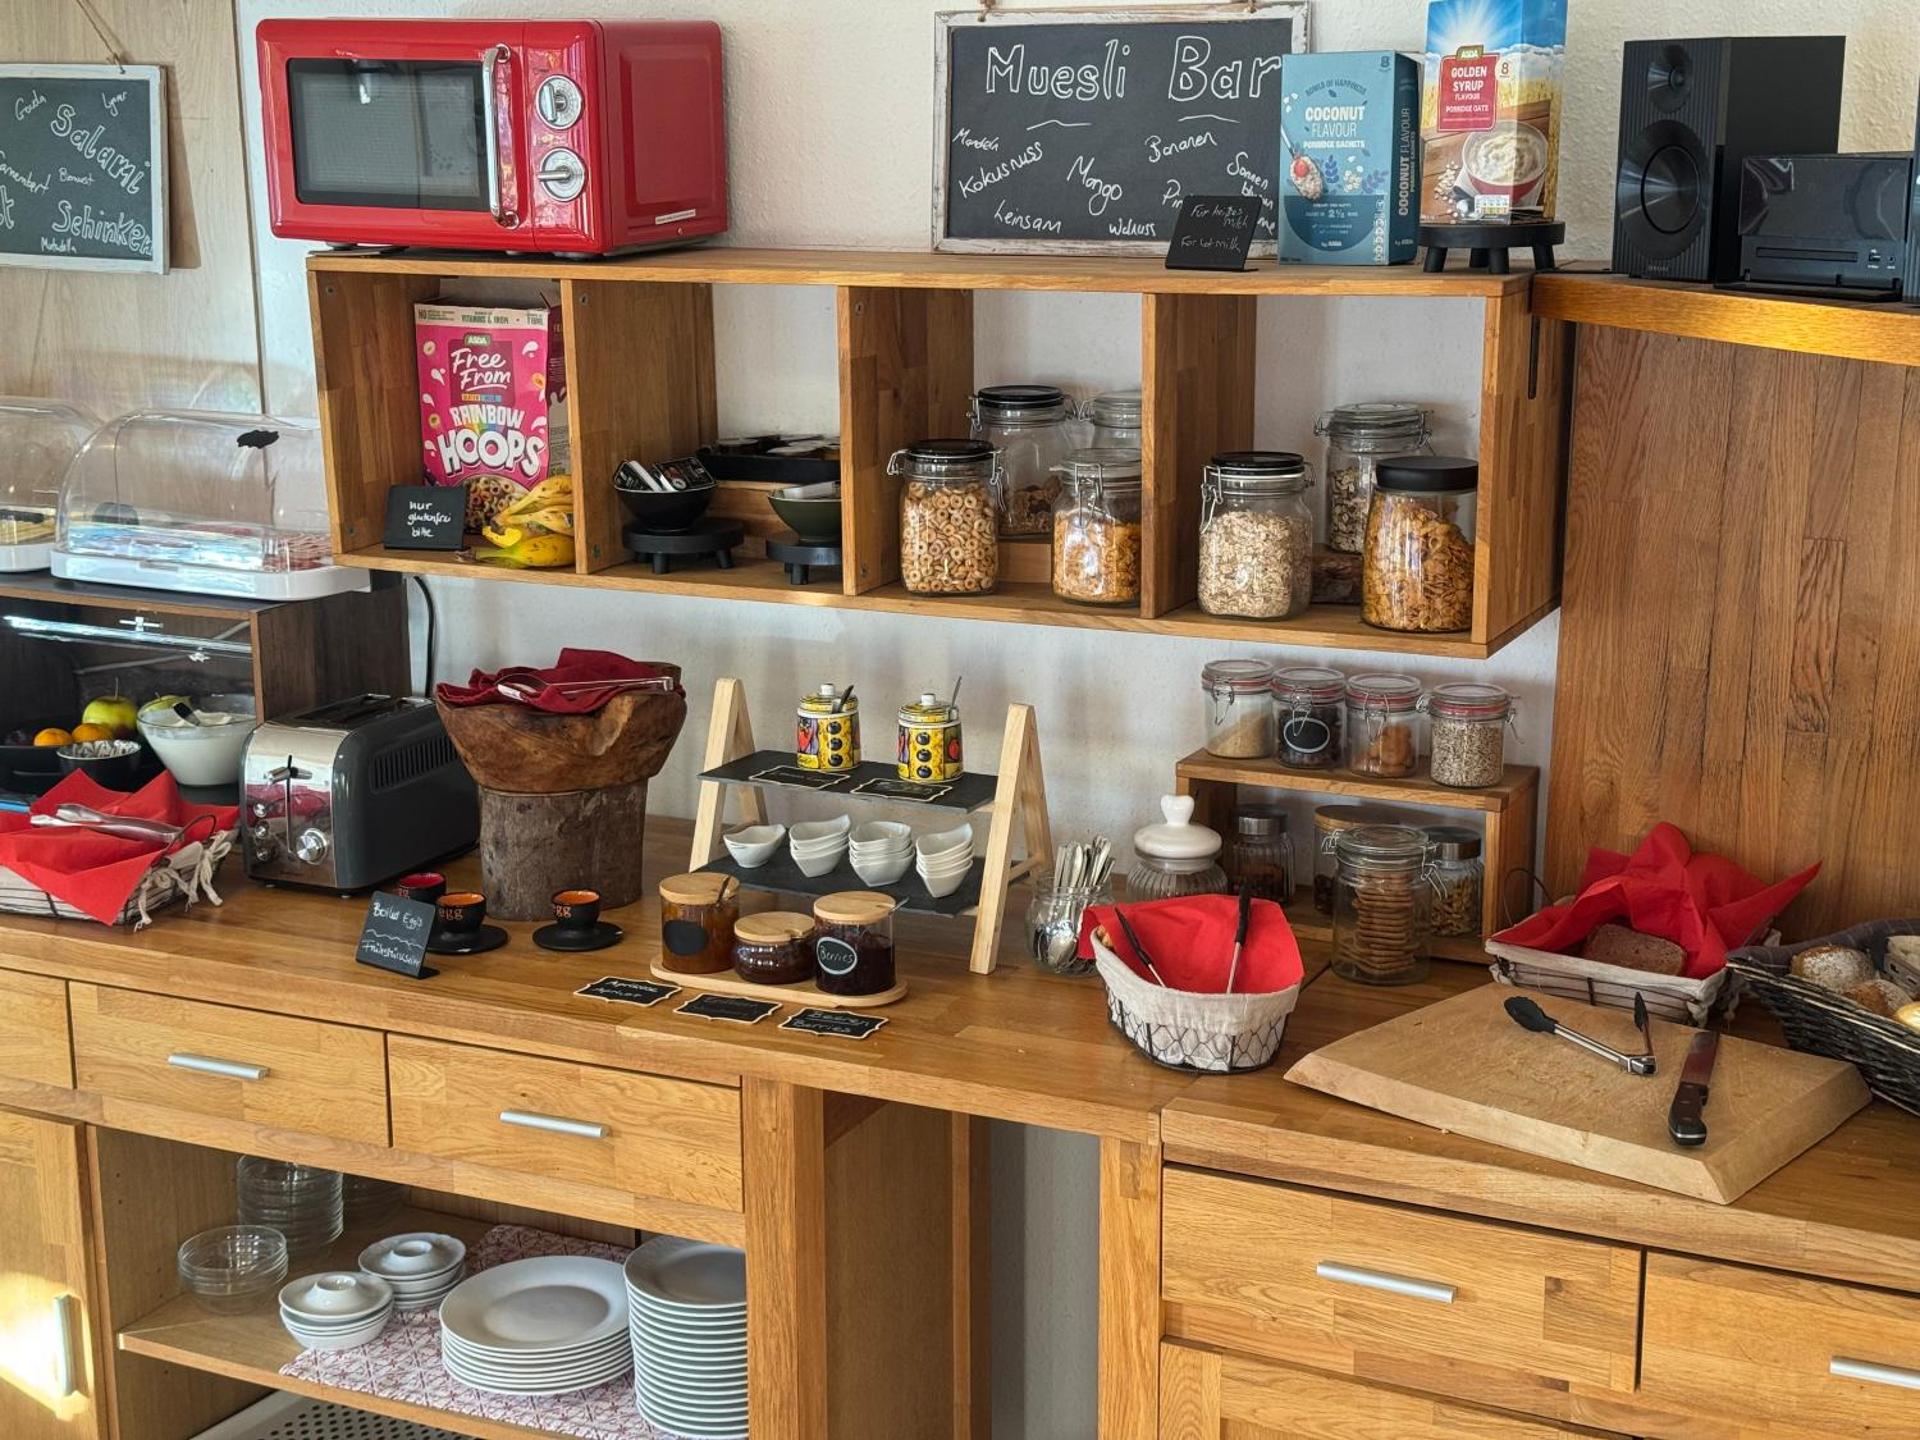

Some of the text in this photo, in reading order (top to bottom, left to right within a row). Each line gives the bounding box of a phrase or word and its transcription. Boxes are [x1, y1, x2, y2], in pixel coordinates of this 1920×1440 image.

[985, 35, 1282, 101] Muesli Bar
[1451, 66, 1488, 78] GOLDEN
[1501, 62, 1509, 74] 8
[1453, 80, 1485, 92] SYRUP
[1305, 106, 1366, 121] COCONUT
[1312, 122, 1358, 138] FLAVOUR
[51, 104, 152, 194] Salami
[1145, 131, 1218, 163] Bananen
[1399, 108, 1410, 216] COCONUT FLAVOUR
[52, 200, 154, 256] Schinken
[451, 348, 506, 374] Free
[460, 368, 512, 390] From
[449, 404, 525, 428] RAINBOW
[437, 430, 547, 476] HOOPS
